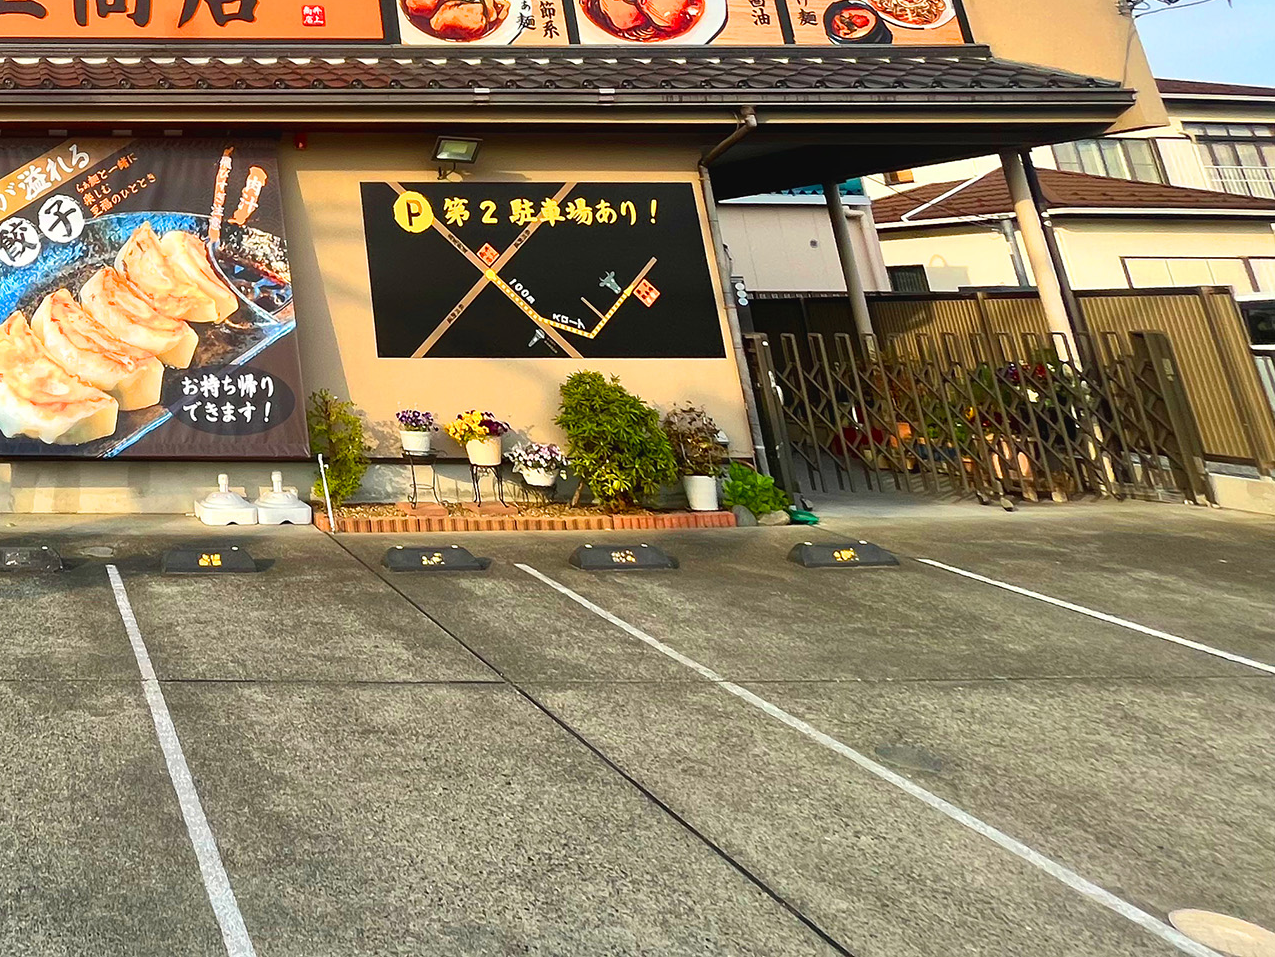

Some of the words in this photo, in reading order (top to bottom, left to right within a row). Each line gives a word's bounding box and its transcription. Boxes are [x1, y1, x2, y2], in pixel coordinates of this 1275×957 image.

[76, 152, 138, 193] らぁ麺と一緒に
[83, 184, 111, 206] 楽しむ
[90, 173, 156, 218] 至福のひととき
[406, 200, 422, 227] P
[181, 373, 274, 398] お持ち帰り
[183, 401, 271, 423] できます！
